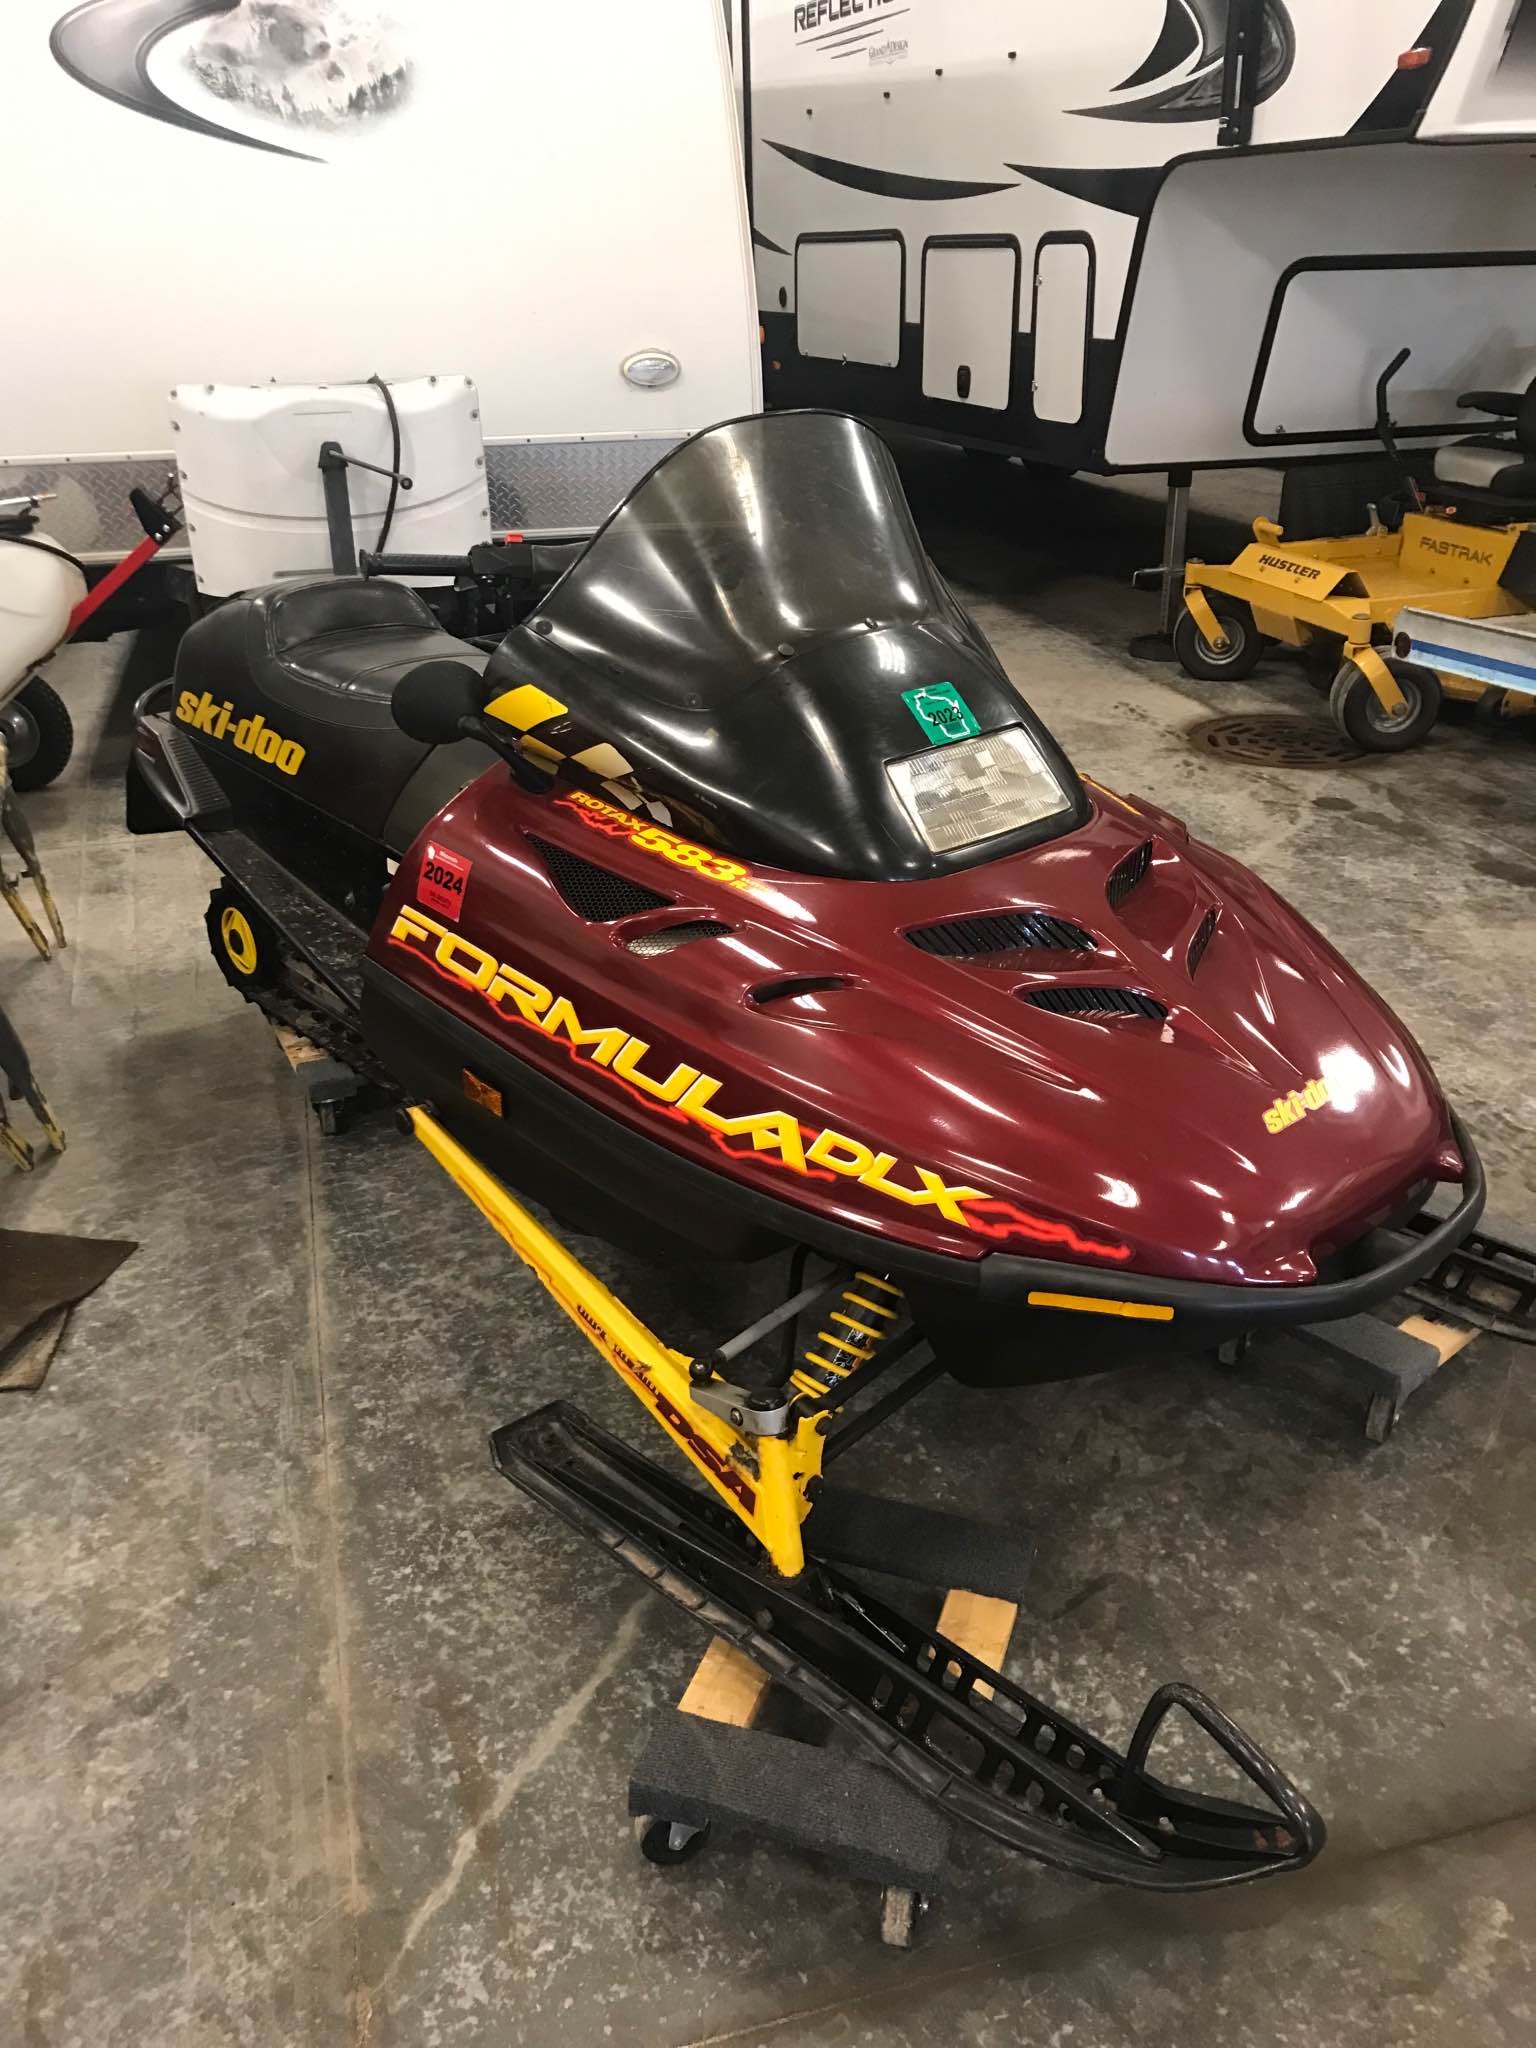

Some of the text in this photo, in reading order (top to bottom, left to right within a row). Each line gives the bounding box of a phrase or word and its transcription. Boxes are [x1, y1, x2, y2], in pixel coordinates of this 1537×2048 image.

[1258, 553, 1322, 580] HUSTLER
[1418, 536, 1494, 567] FASTRAK
[175, 690, 306, 776] ski-doo
[927, 706, 964, 727] 2023
[569, 791, 747, 881] ROTAX 583
[423, 861, 464, 895] 2024
[390, 903, 995, 1227] FORMULA DLX
[1262, 1077, 1331, 1134] ski-do
[655, 1393, 757, 1517] DSA
